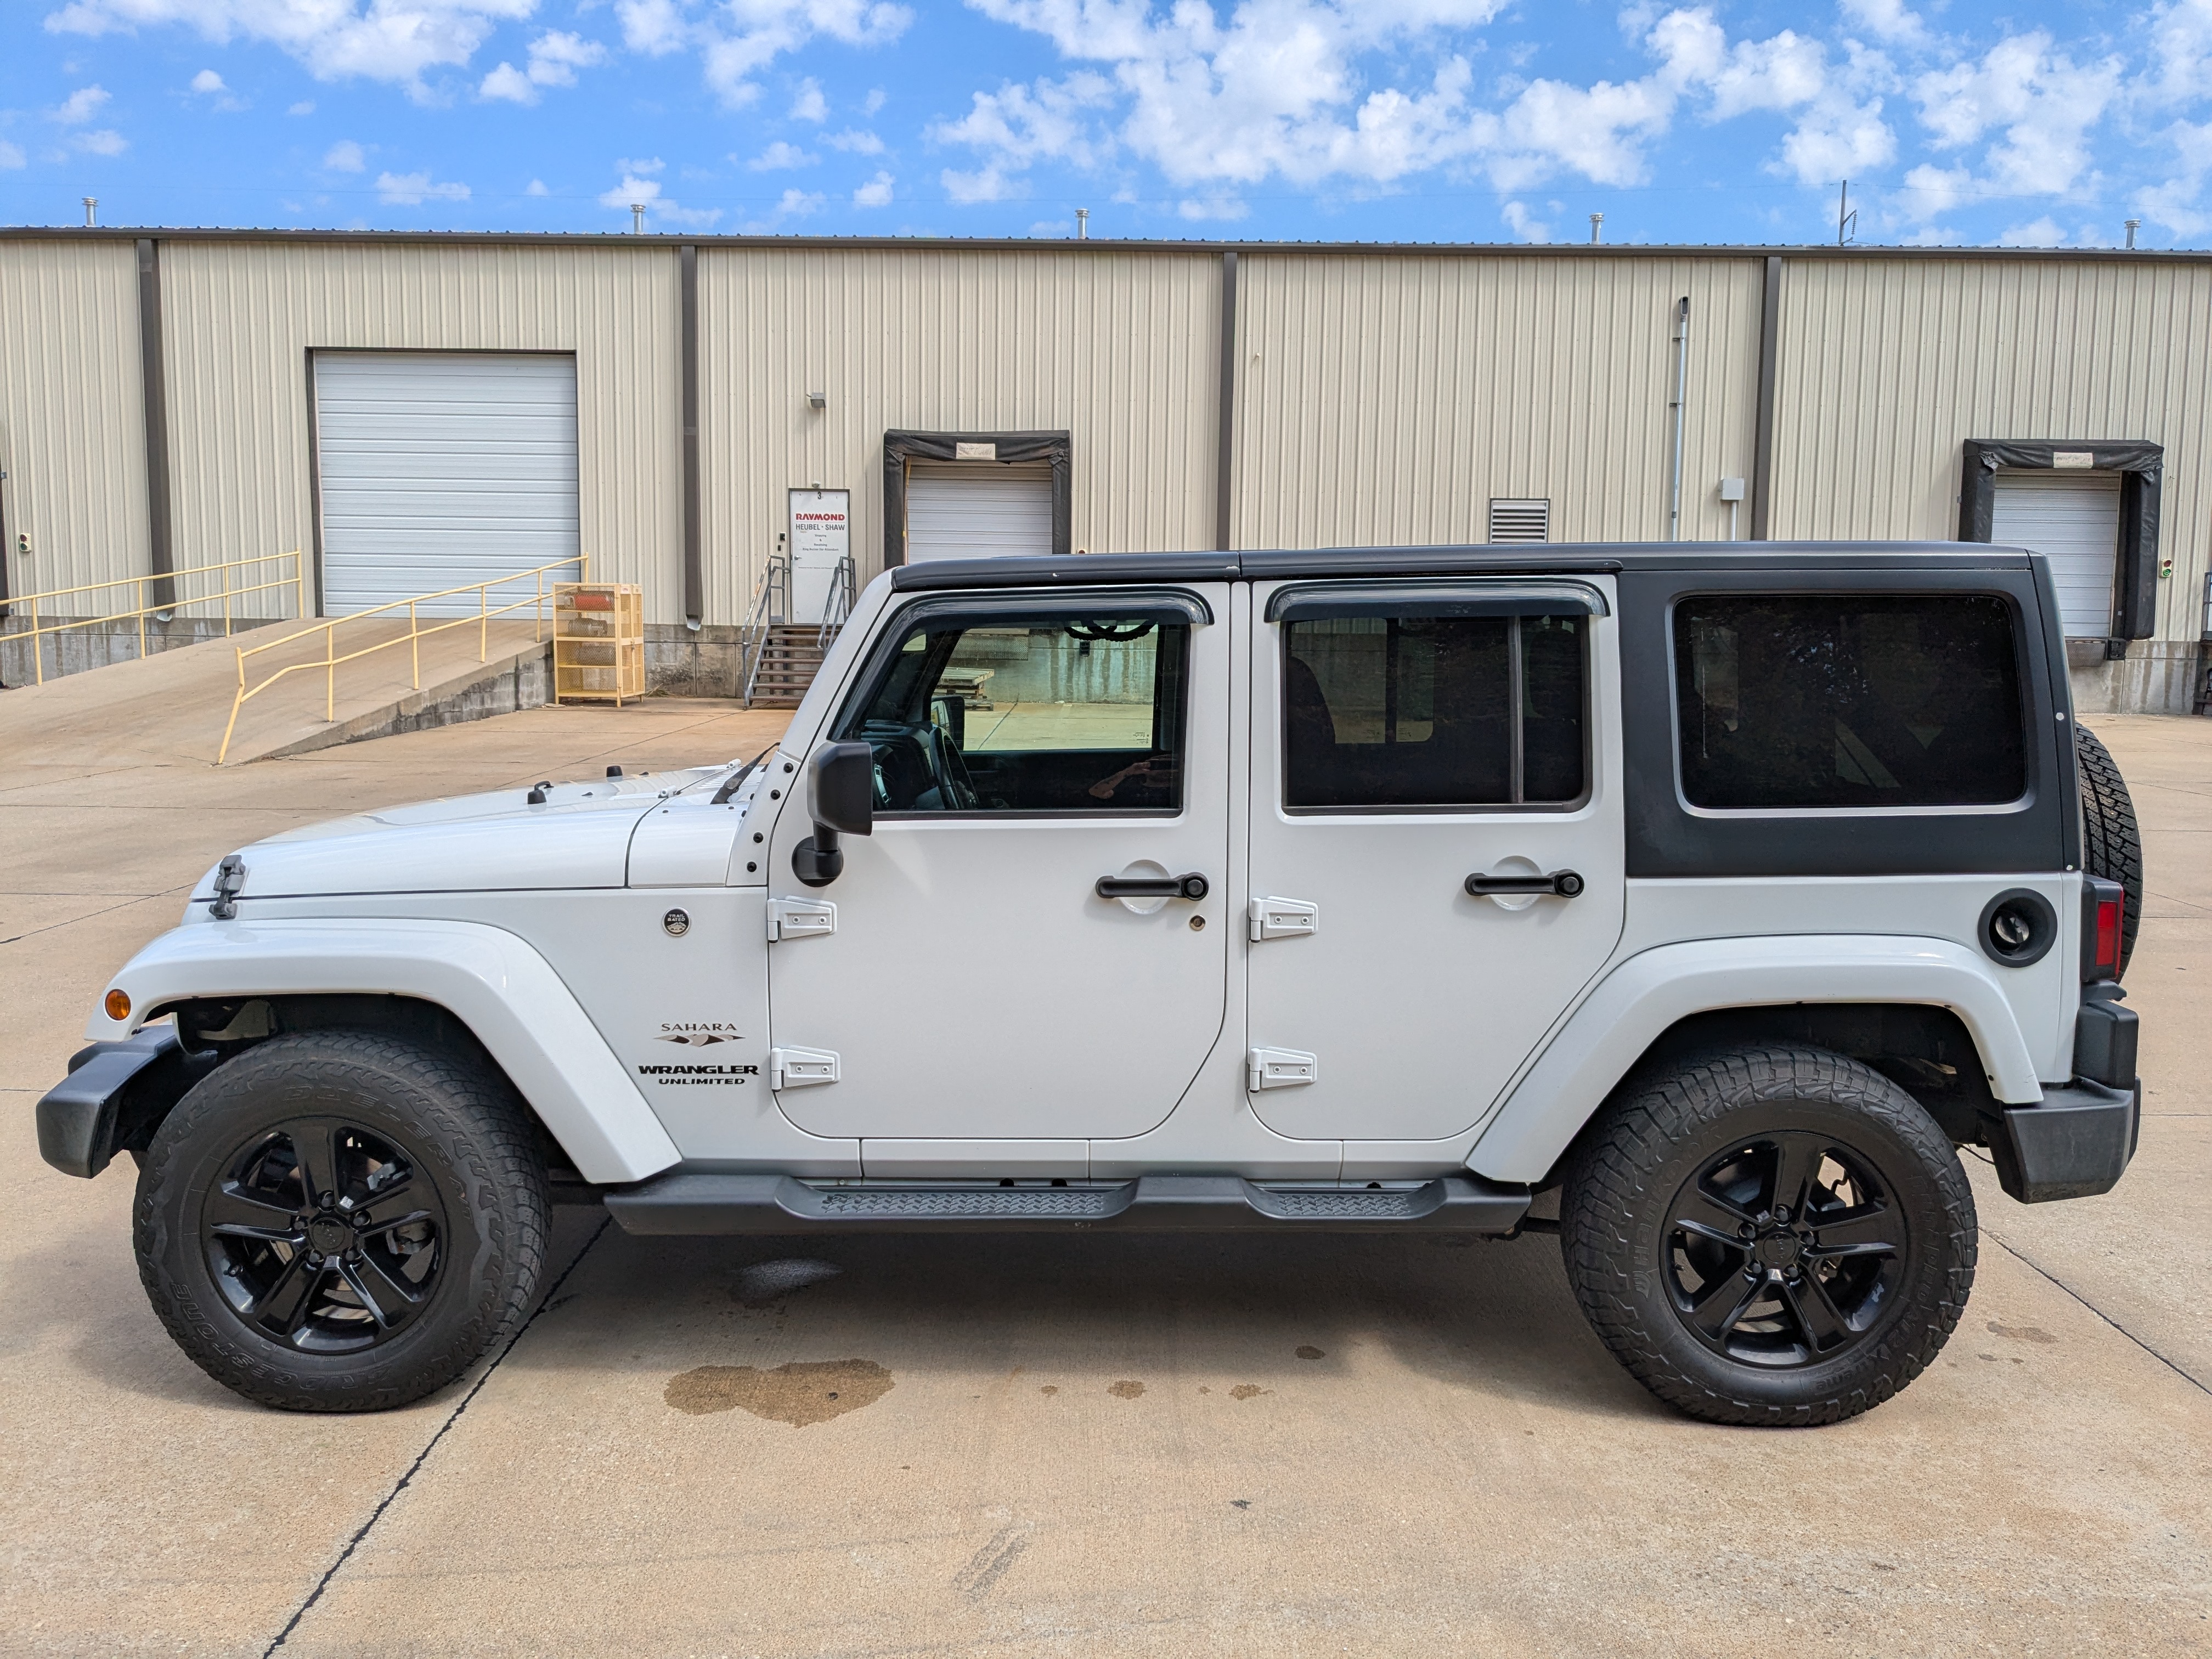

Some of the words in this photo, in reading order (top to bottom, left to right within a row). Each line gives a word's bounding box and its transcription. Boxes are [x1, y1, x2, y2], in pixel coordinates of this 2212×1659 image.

[817, 491, 822, 500] 3
[661, 1023, 737, 1031] SAHARA
[639, 1065, 759, 1075] WRANGLER
[171, 1281, 396, 1391] BRIDGESTONE
